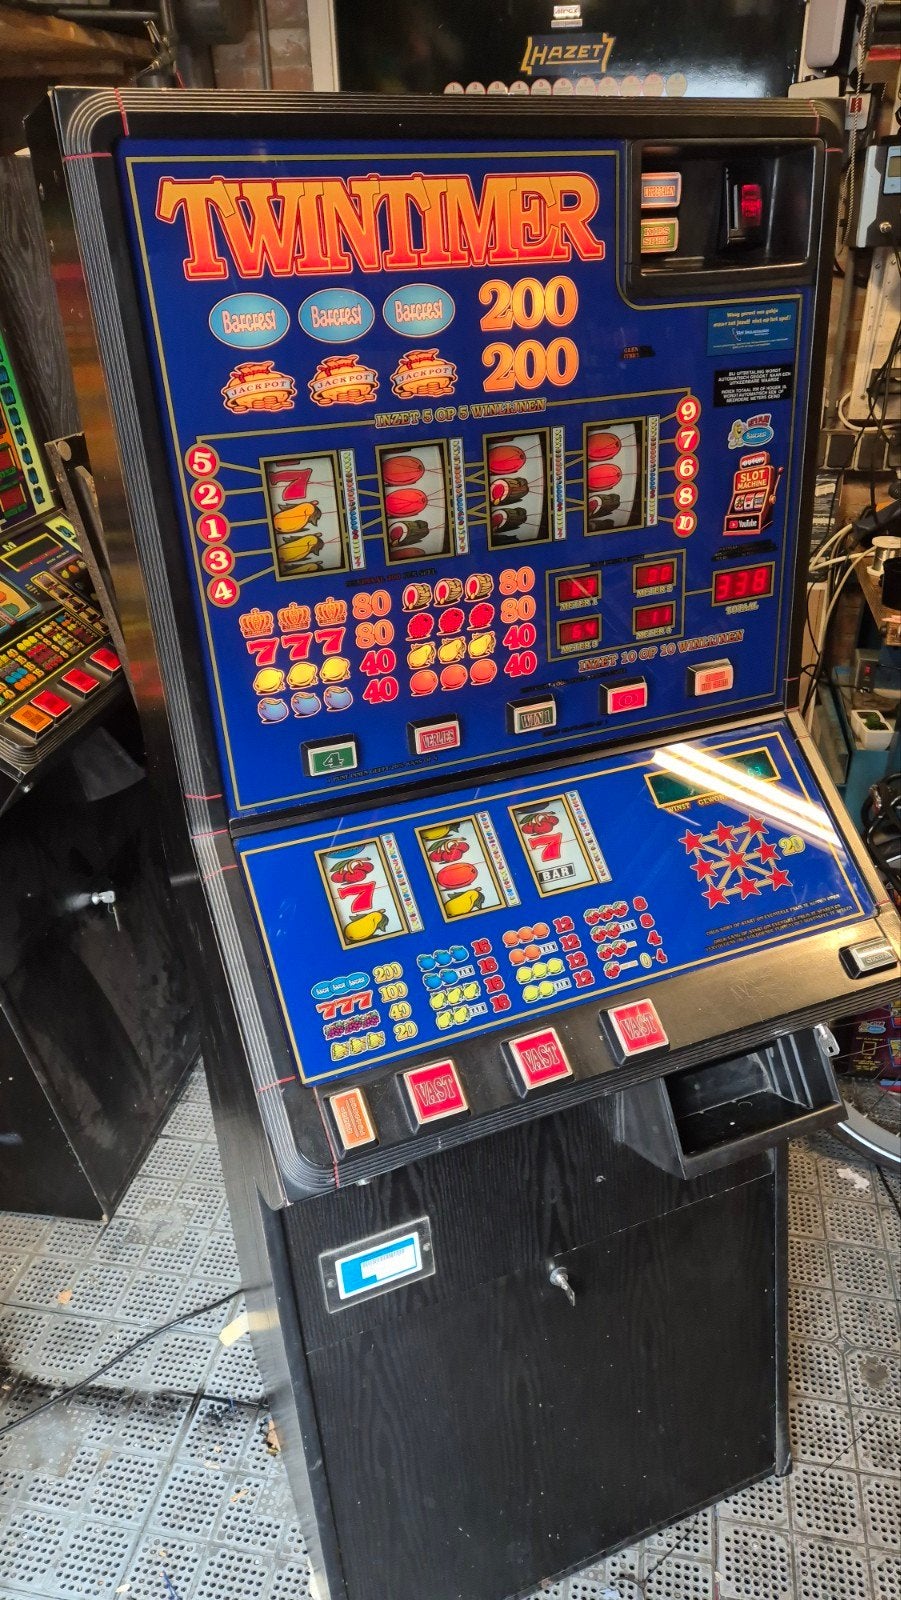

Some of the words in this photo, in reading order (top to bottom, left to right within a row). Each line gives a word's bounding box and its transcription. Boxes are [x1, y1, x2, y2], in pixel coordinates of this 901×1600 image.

[530, 44, 604, 66] HAZET
[156, 172, 606, 281] TWINTIMER
[221, 311, 277, 333] Barcrest
[310, 304, 363, 327] Barcrest
[394, 299, 444, 323] Barcrest
[478, 275, 579, 332] 200
[230, 379, 289, 398] JACKPOT
[316, 372, 371, 390] JACKPOT
[398, 366, 451, 384] JACKPOT
[480, 336, 580, 392] 200
[375, 412, 420, 429] INZET
[422, 409, 434, 423] 5
[434, 407, 456, 422] OP
[458, 405, 469, 420] 5
[470, 397, 547, 418] WINLIJNEN
[681, 402, 696, 419] 9
[680, 431, 695, 448] 7
[192, 451, 212, 473] 5
[679, 460, 694, 477] 6
[269, 468, 313, 501] 7
[737, 479, 767, 490] MACHINE
[740, 470, 766, 483] SLOT
[198, 485, 218, 505] 2
[678, 487, 693, 505] 8
[206, 519, 221, 539] 1
[679, 515, 694, 530] 10
[739, 519, 758, 528] YouTube
[210, 550, 228, 571] 3
[214, 581, 233, 600] 4
[499, 566, 536, 596] 80
[714, 566, 769, 602] 338
[352, 589, 392, 620] 80
[500, 595, 537, 624] 80
[246, 637, 279, 667] 7
[281, 632, 313, 661] 7
[314, 626, 347, 656] 7
[355, 618, 395, 649] 80
[502, 622, 537, 650] 40
[359, 647, 397, 677] 40
[504, 650, 538, 678] 40
[578, 653, 618, 673] INZET
[621, 649, 638, 664] 10
[638, 646, 659, 660] OP
[659, 642, 676, 656] 10
[362, 675, 400, 705] 40
[521, 711, 544, 729] WIN
[422, 728, 455, 749] VERLIES
[322, 751, 345, 768] 4
[528, 832, 563, 862] 7
[778, 834, 806, 857] 20
[542, 865, 574, 882] BAR
[337, 881, 376, 913] 7
[552, 915, 575, 934] 12
[633, 896, 648, 912] 8
[559, 933, 582, 952] 12
[639, 913, 655, 929] 8
[471, 937, 492, 957] 16
[565, 951, 588, 970] 12
[647, 930, 663, 946] 4
[372, 961, 403, 984] 200
[477, 956, 499, 975] 16
[483, 974, 505, 994] 16
[572, 969, 595, 988] 12
[378, 981, 409, 1003] 100
[490, 993, 512, 1013] 16
[389, 1001, 412, 1021] 40
[393, 1020, 418, 1042] 20
[414, 1074, 456, 1107] VAST
[521, 1042, 560, 1073] VAST
[619, 1012, 658, 1042] VAST
